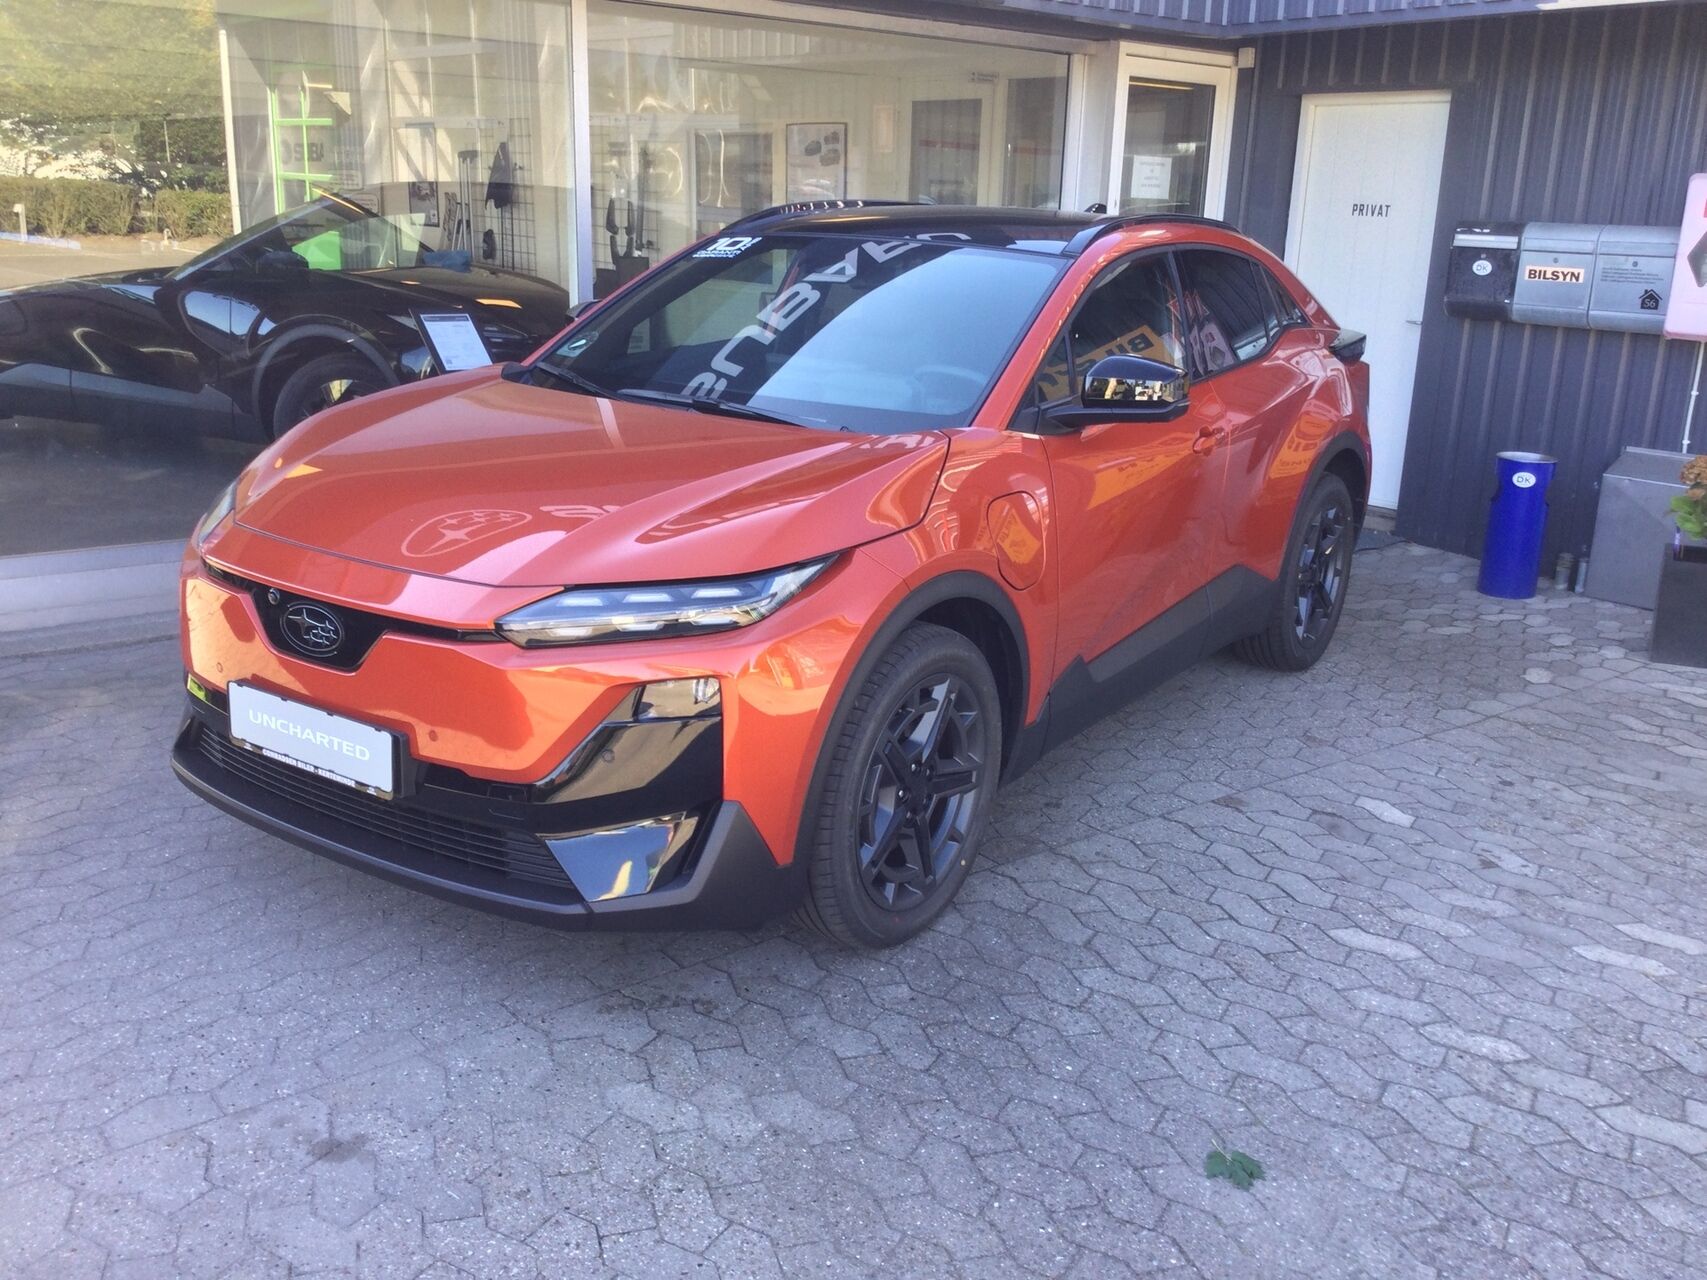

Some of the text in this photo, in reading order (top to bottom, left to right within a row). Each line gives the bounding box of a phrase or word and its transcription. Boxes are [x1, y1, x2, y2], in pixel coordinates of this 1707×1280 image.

[1352, 203, 1391, 217] PRIVAT
[705, 237, 752, 251] 10
[1476, 264, 1488, 273] DK
[1528, 269, 1580, 282] BILSYN
[1644, 299, 1656, 308] 56
[1516, 476, 1531, 485] DK
[249, 709, 370, 761] UNCHARTED
